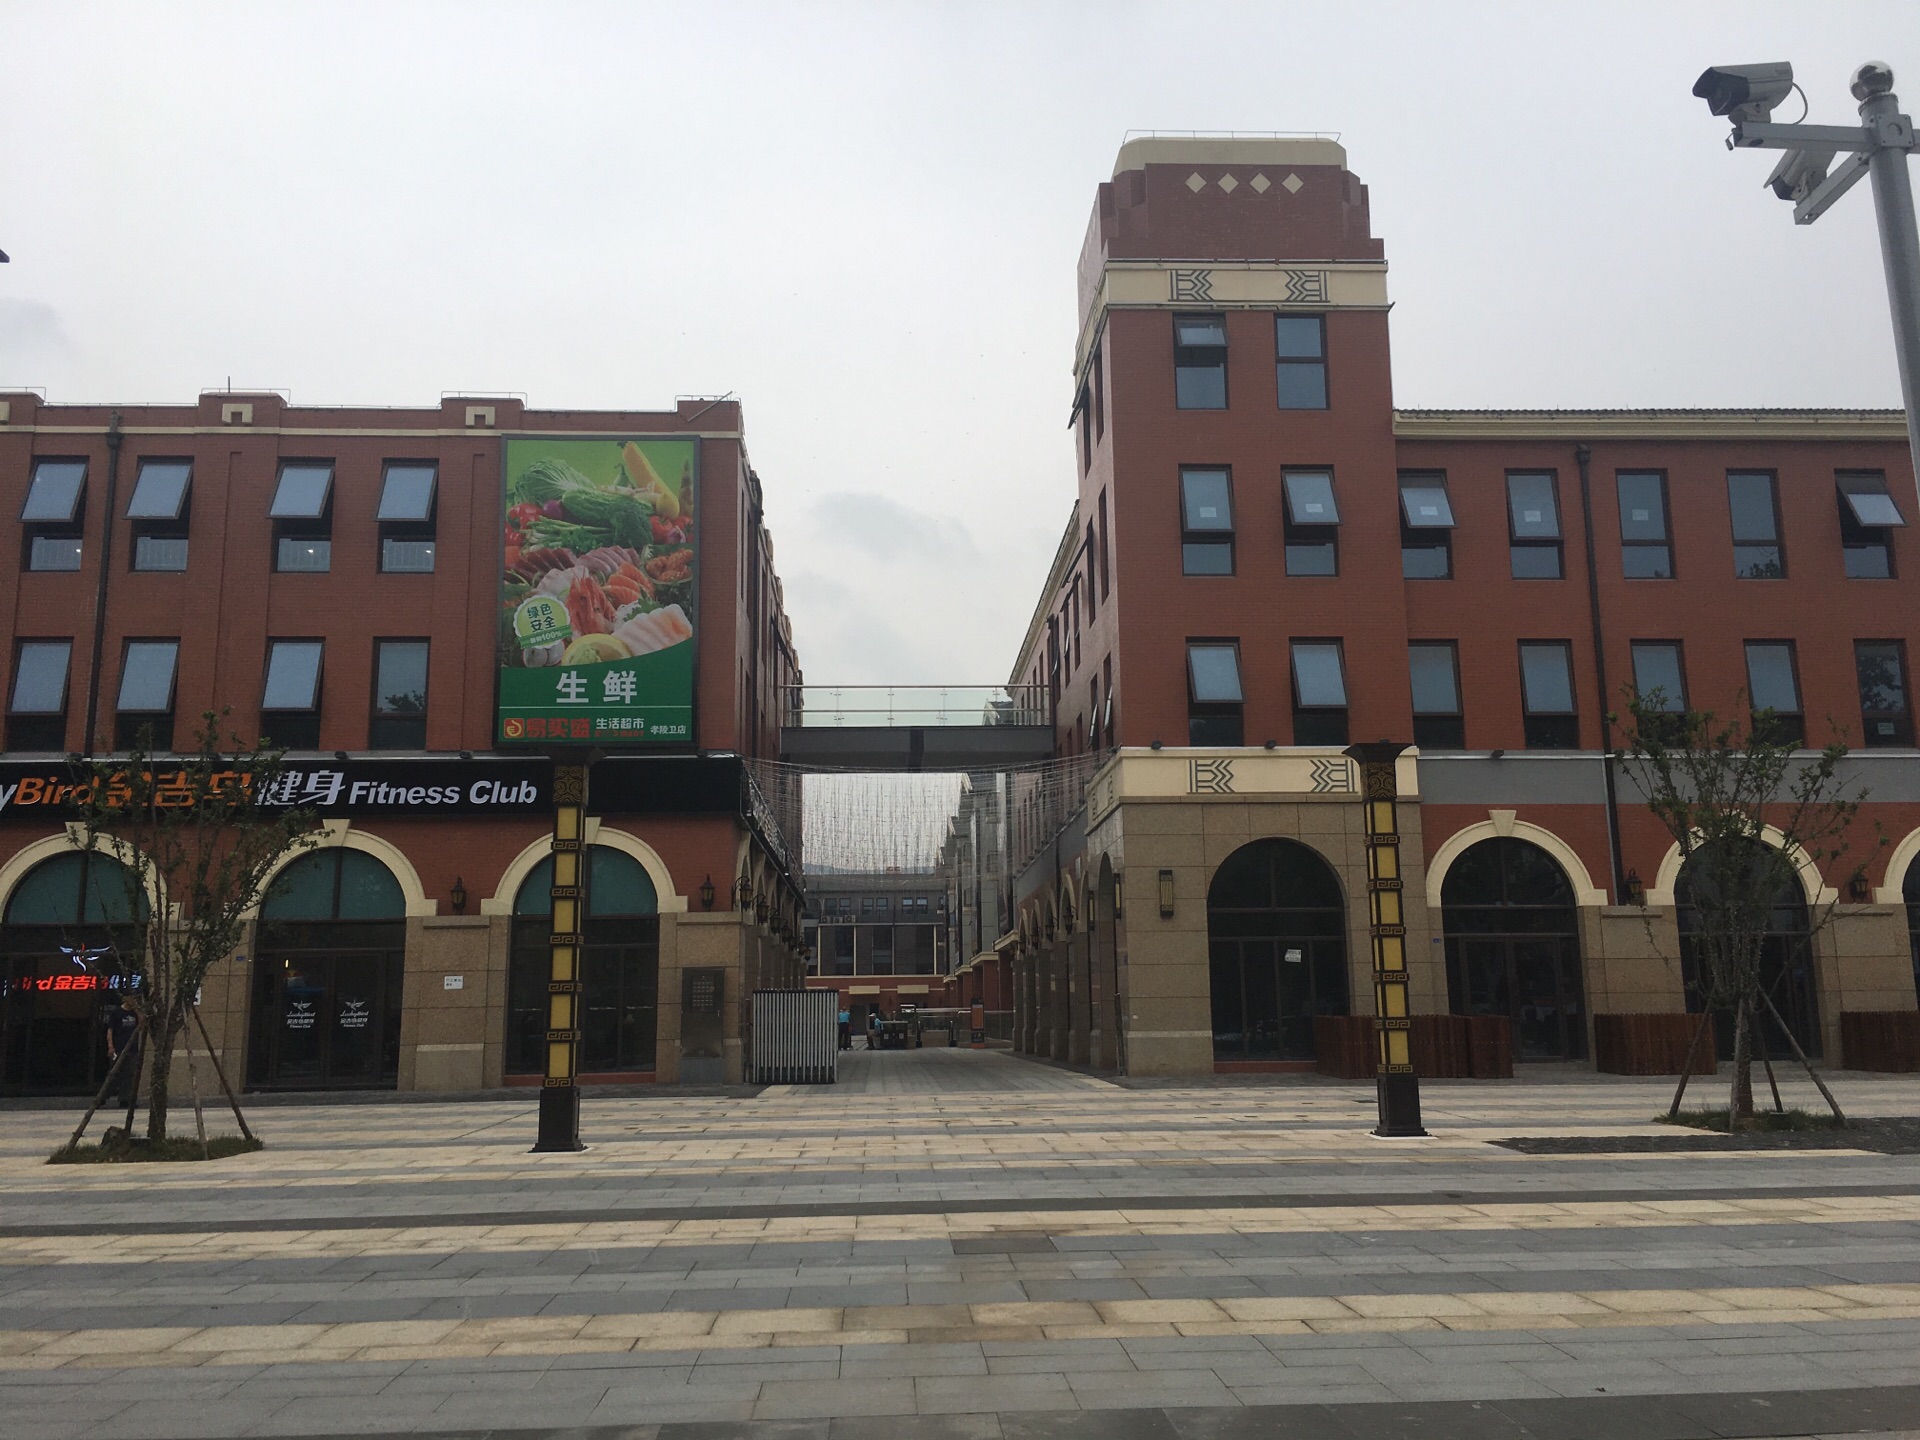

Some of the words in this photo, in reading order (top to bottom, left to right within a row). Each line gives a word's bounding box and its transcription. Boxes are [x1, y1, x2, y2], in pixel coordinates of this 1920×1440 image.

[527, 603, 552, 618] 绿色
[530, 616, 556, 632] 安全
[556, 670, 638, 704] 生鲜
[596, 717, 645, 730] 生活超市
[650, 724, 686, 735] 孝陵卫店
[349, 781, 460, 804] Fitness
[469, 780, 537, 804] Club
